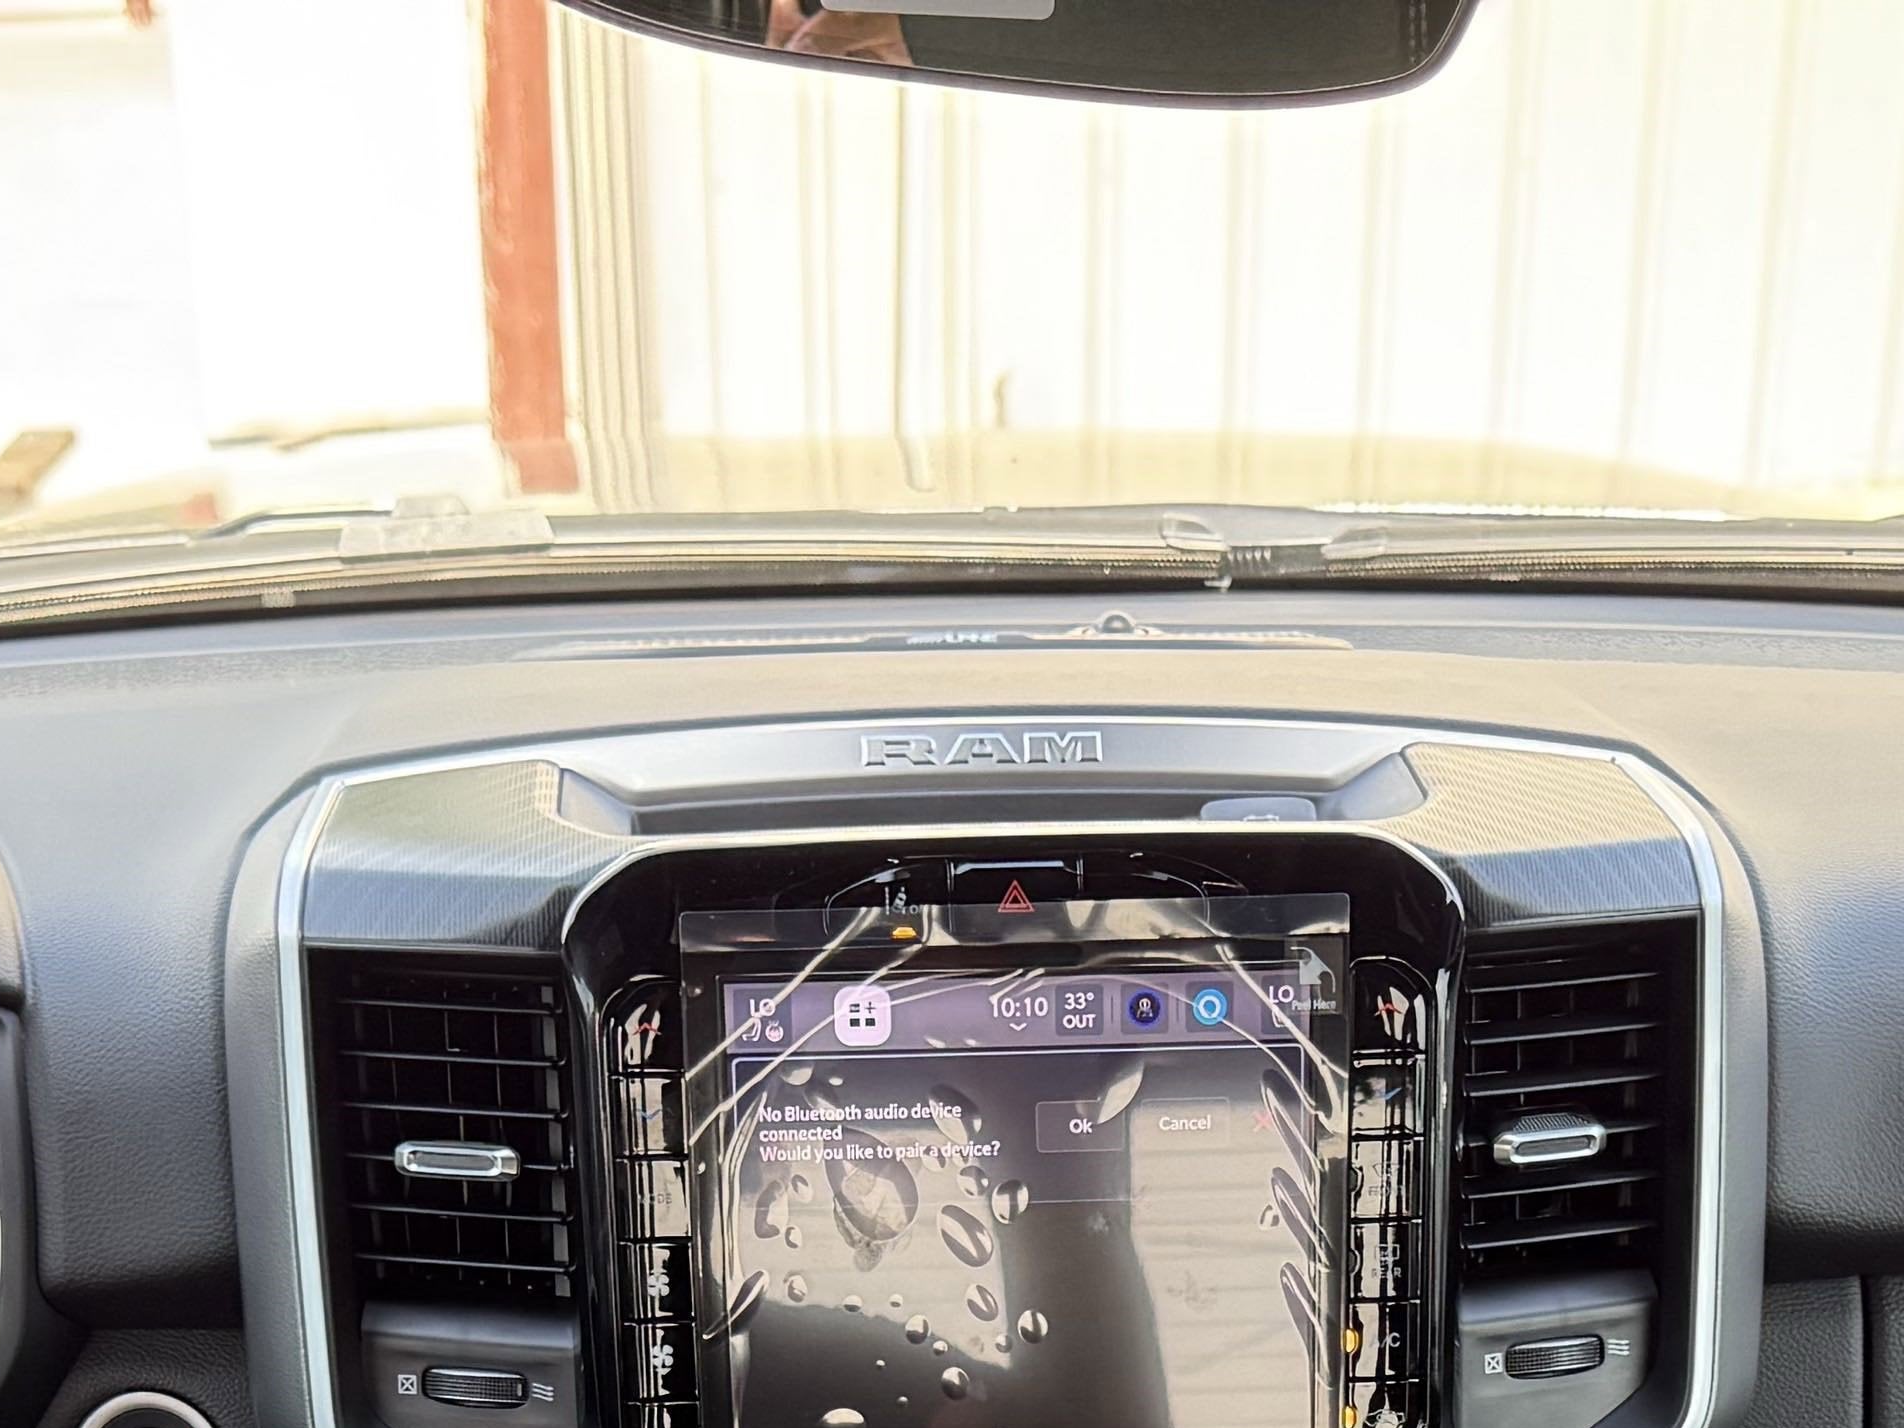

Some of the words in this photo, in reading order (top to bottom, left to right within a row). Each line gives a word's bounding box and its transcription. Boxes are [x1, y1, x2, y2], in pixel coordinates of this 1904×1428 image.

[860, 729, 1103, 766] RAM
[1064, 991, 1095, 1009] 33°
[1268, 984, 1295, 1004] LO
[991, 997, 1048, 1018] 10:10
[1062, 1014, 1096, 1029] OUT
[759, 1106, 782, 1122] No
[784, 1104, 862, 1122] Bluetooth
[864, 1103, 909, 1120] audio
[910, 1102, 962, 1119] device
[1068, 1118, 1093, 1134] Ok
[1158, 1114, 1212, 1132] Cancel
[759, 1125, 843, 1142] connected
[760, 1145, 812, 1162] Would
[814, 1147, 844, 1164] you
[845, 1144, 875, 1160] like
[876, 1144, 893, 1160] to
[895, 1143, 928, 1163] pair
[929, 1146, 939, 1158] a
[941, 1140, 1001, 1158] device?
